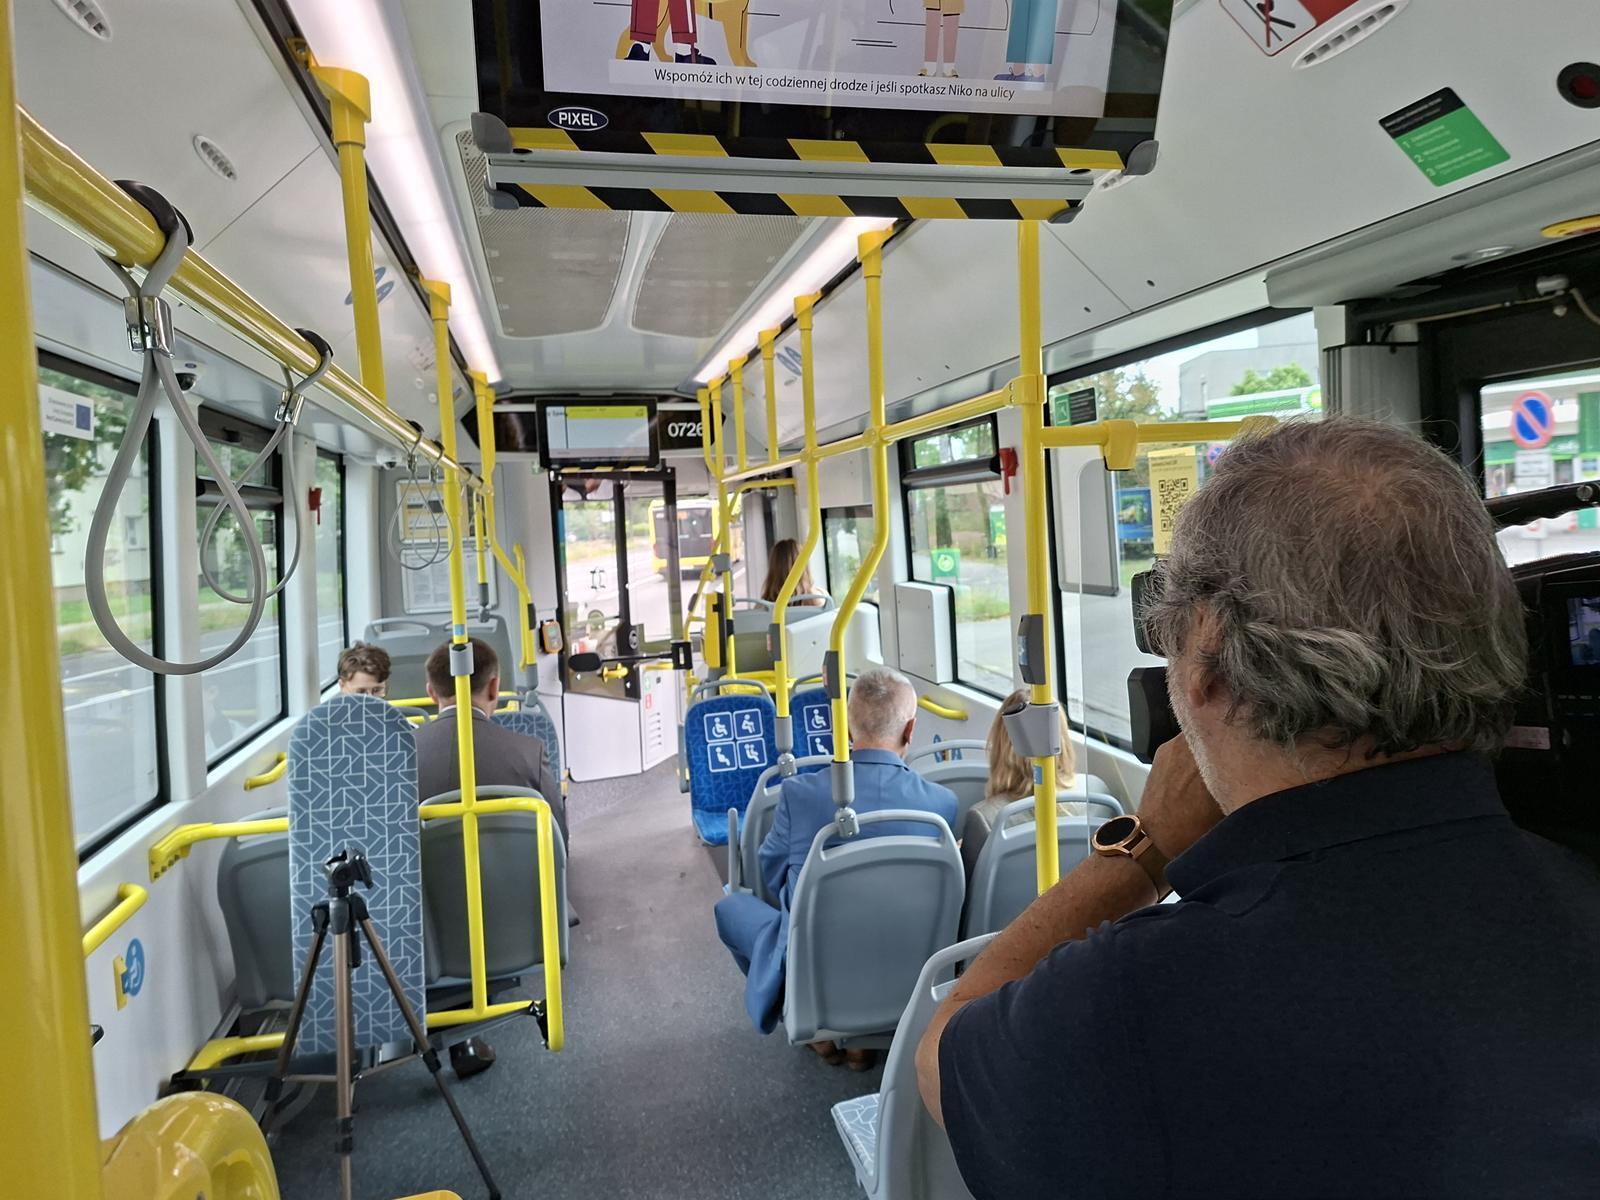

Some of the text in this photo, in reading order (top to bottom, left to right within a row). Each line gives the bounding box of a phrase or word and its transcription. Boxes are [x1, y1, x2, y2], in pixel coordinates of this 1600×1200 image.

[654, 69, 713, 84] Wspomóż
[715, 73, 732, 85] ich
[735, 76, 746, 85] w
[749, 75, 763, 89] tej
[766, 75, 827, 91] codziennej
[830, 78, 868, 91] drodze
[875, 80, 897, 95] jeśli
[900, 81, 946, 96] spotkasz
[949, 84, 973, 97] Niko
[975, 89, 988, 98] na
[990, 86, 1015, 101] ulicy
[558, 111, 598, 127] PIXEL
